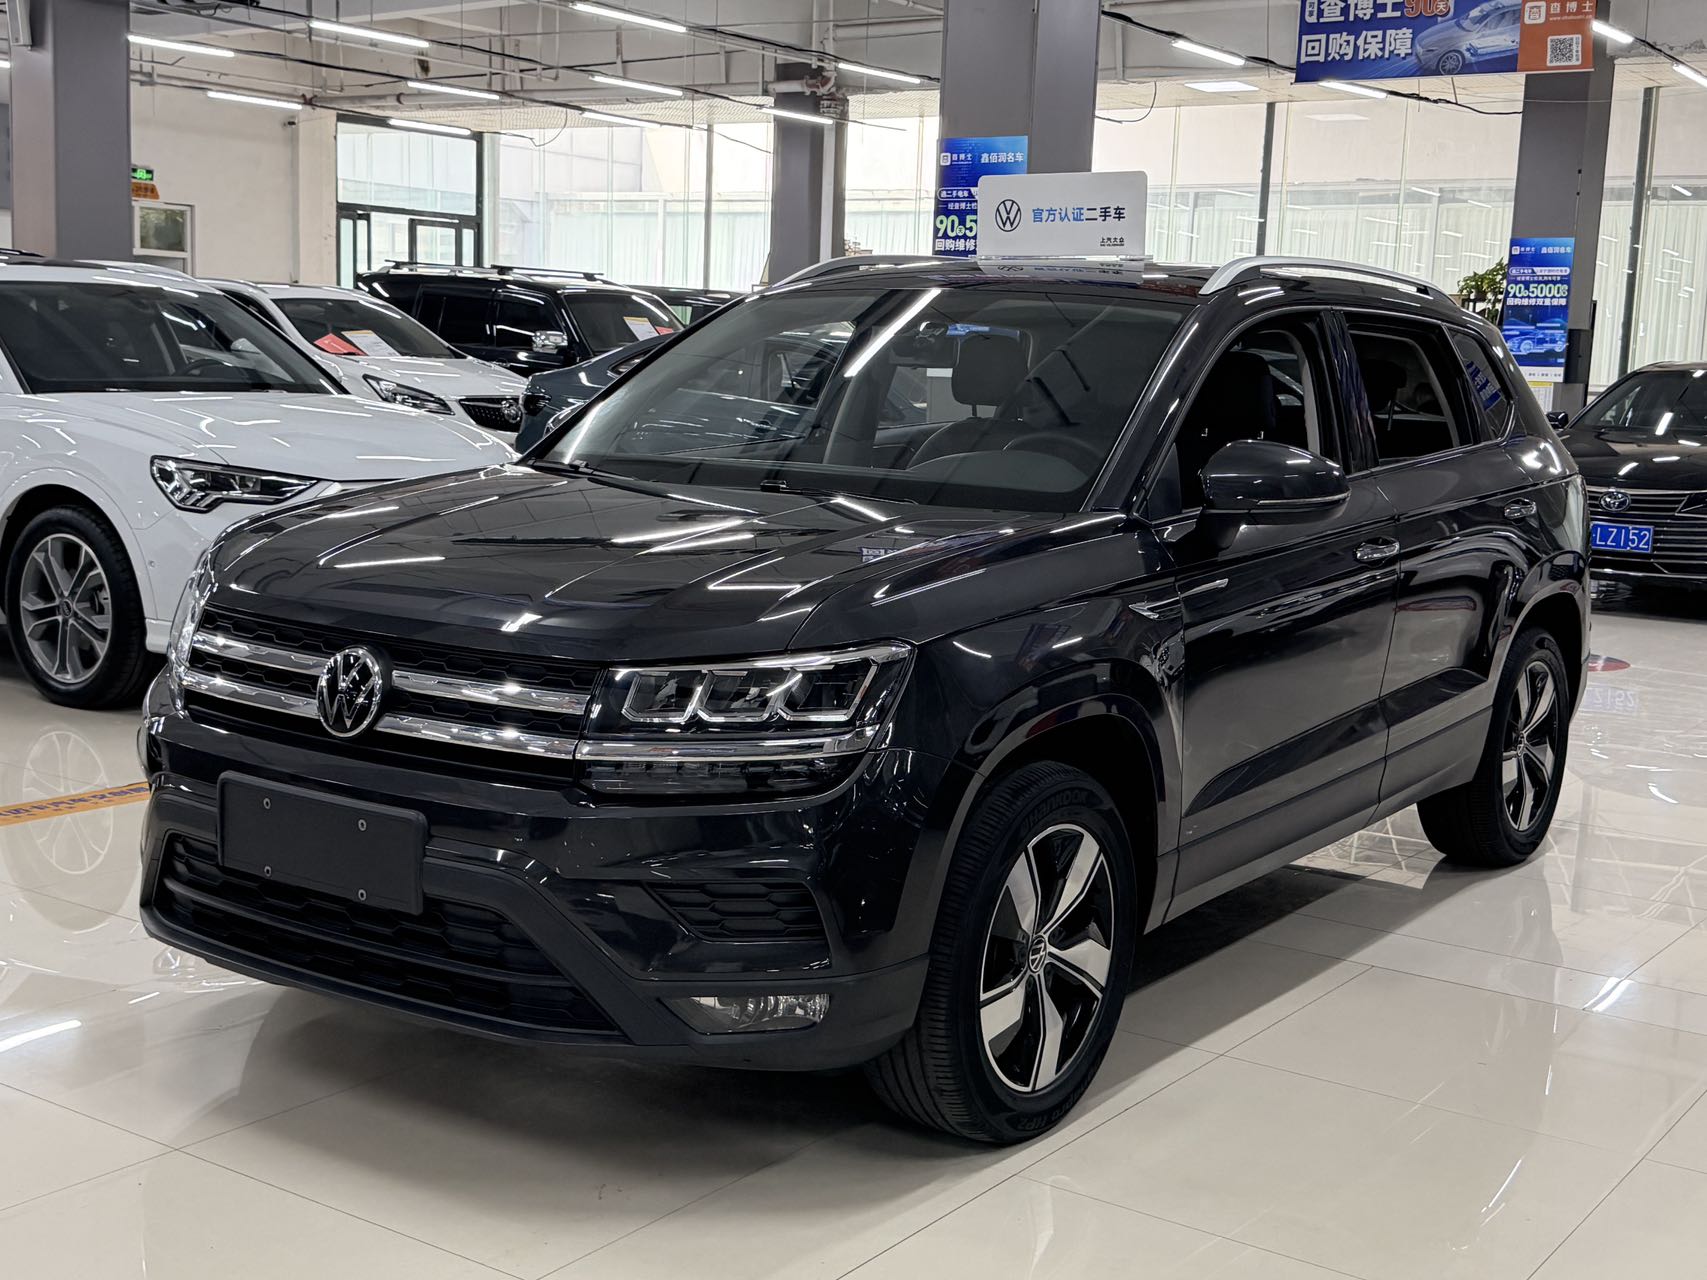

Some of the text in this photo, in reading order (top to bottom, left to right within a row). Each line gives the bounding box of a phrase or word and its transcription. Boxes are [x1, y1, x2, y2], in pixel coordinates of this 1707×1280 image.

[1550, 1, 1593, 14] 查博士
[1300, 28, 1413, 63] 回购保障
[981, 152, 1024, 163] 鑫佰润名车
[1032, 206, 1126, 223] 官方认证二手车
[935, 239, 977, 251] 回购维修
